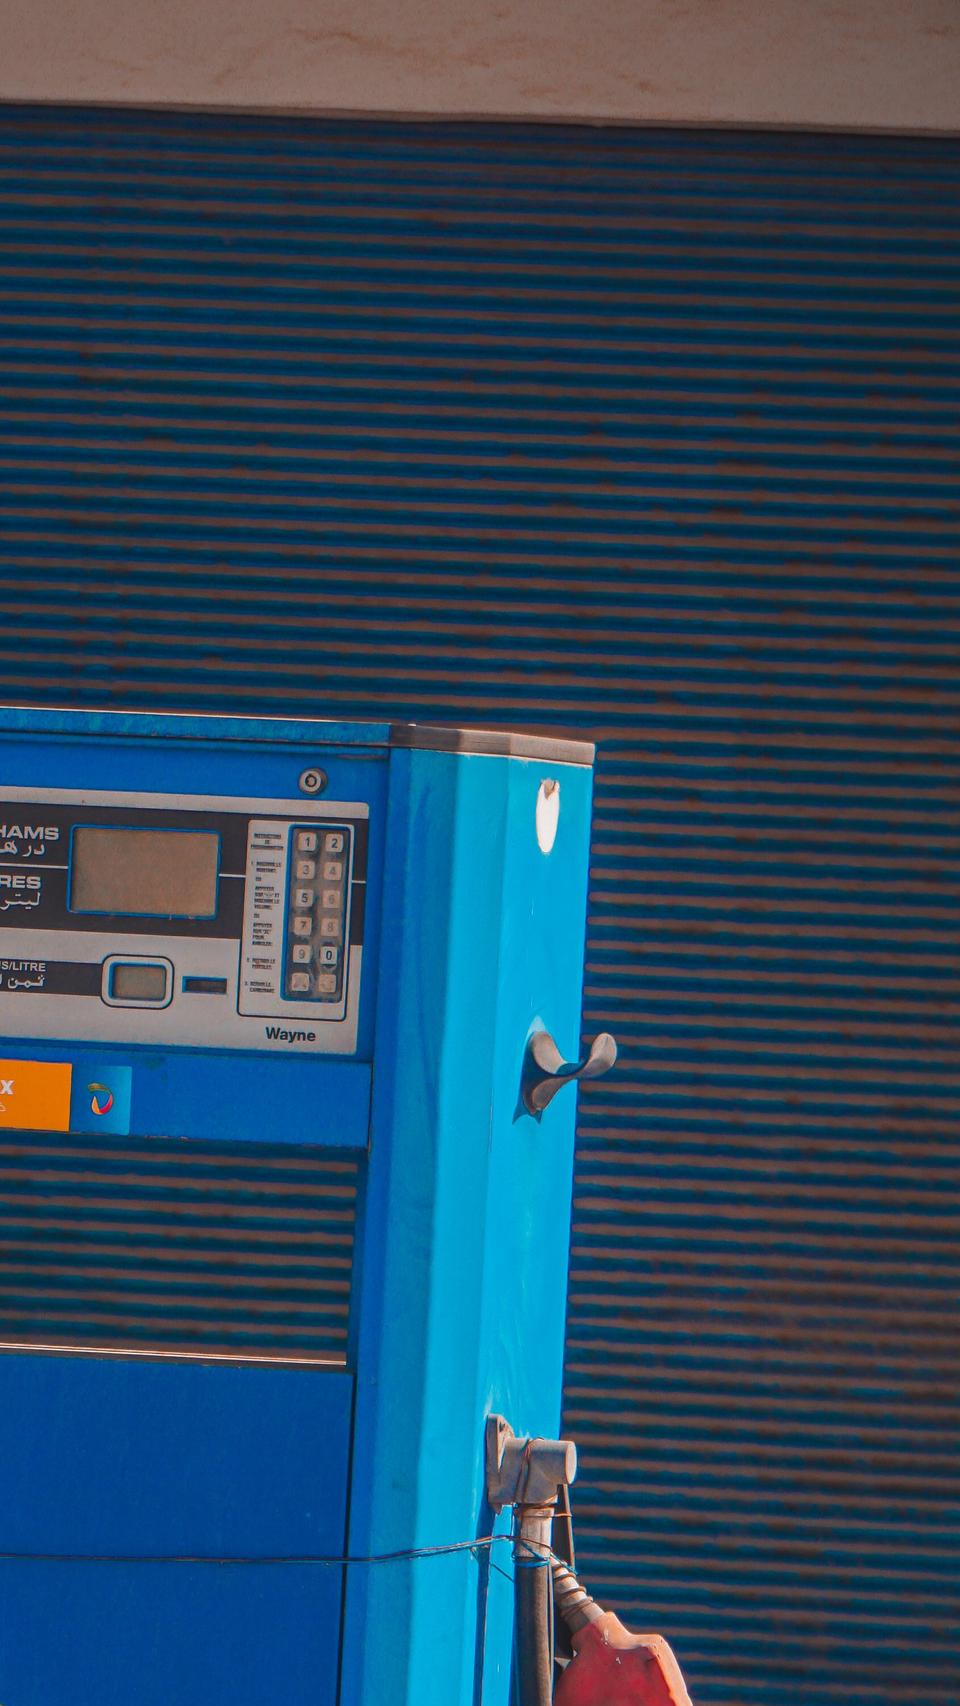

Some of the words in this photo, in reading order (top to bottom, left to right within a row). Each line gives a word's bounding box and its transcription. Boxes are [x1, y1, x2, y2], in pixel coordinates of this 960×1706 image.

[331, 838, 338, 849] 2
[303, 864, 310, 875] 3
[301, 892, 308, 903] 5
[325, 950, 333, 961] 0
[7, 974, 45, 989] ثمن
[265, 1026, 317, 1043] Wayne
